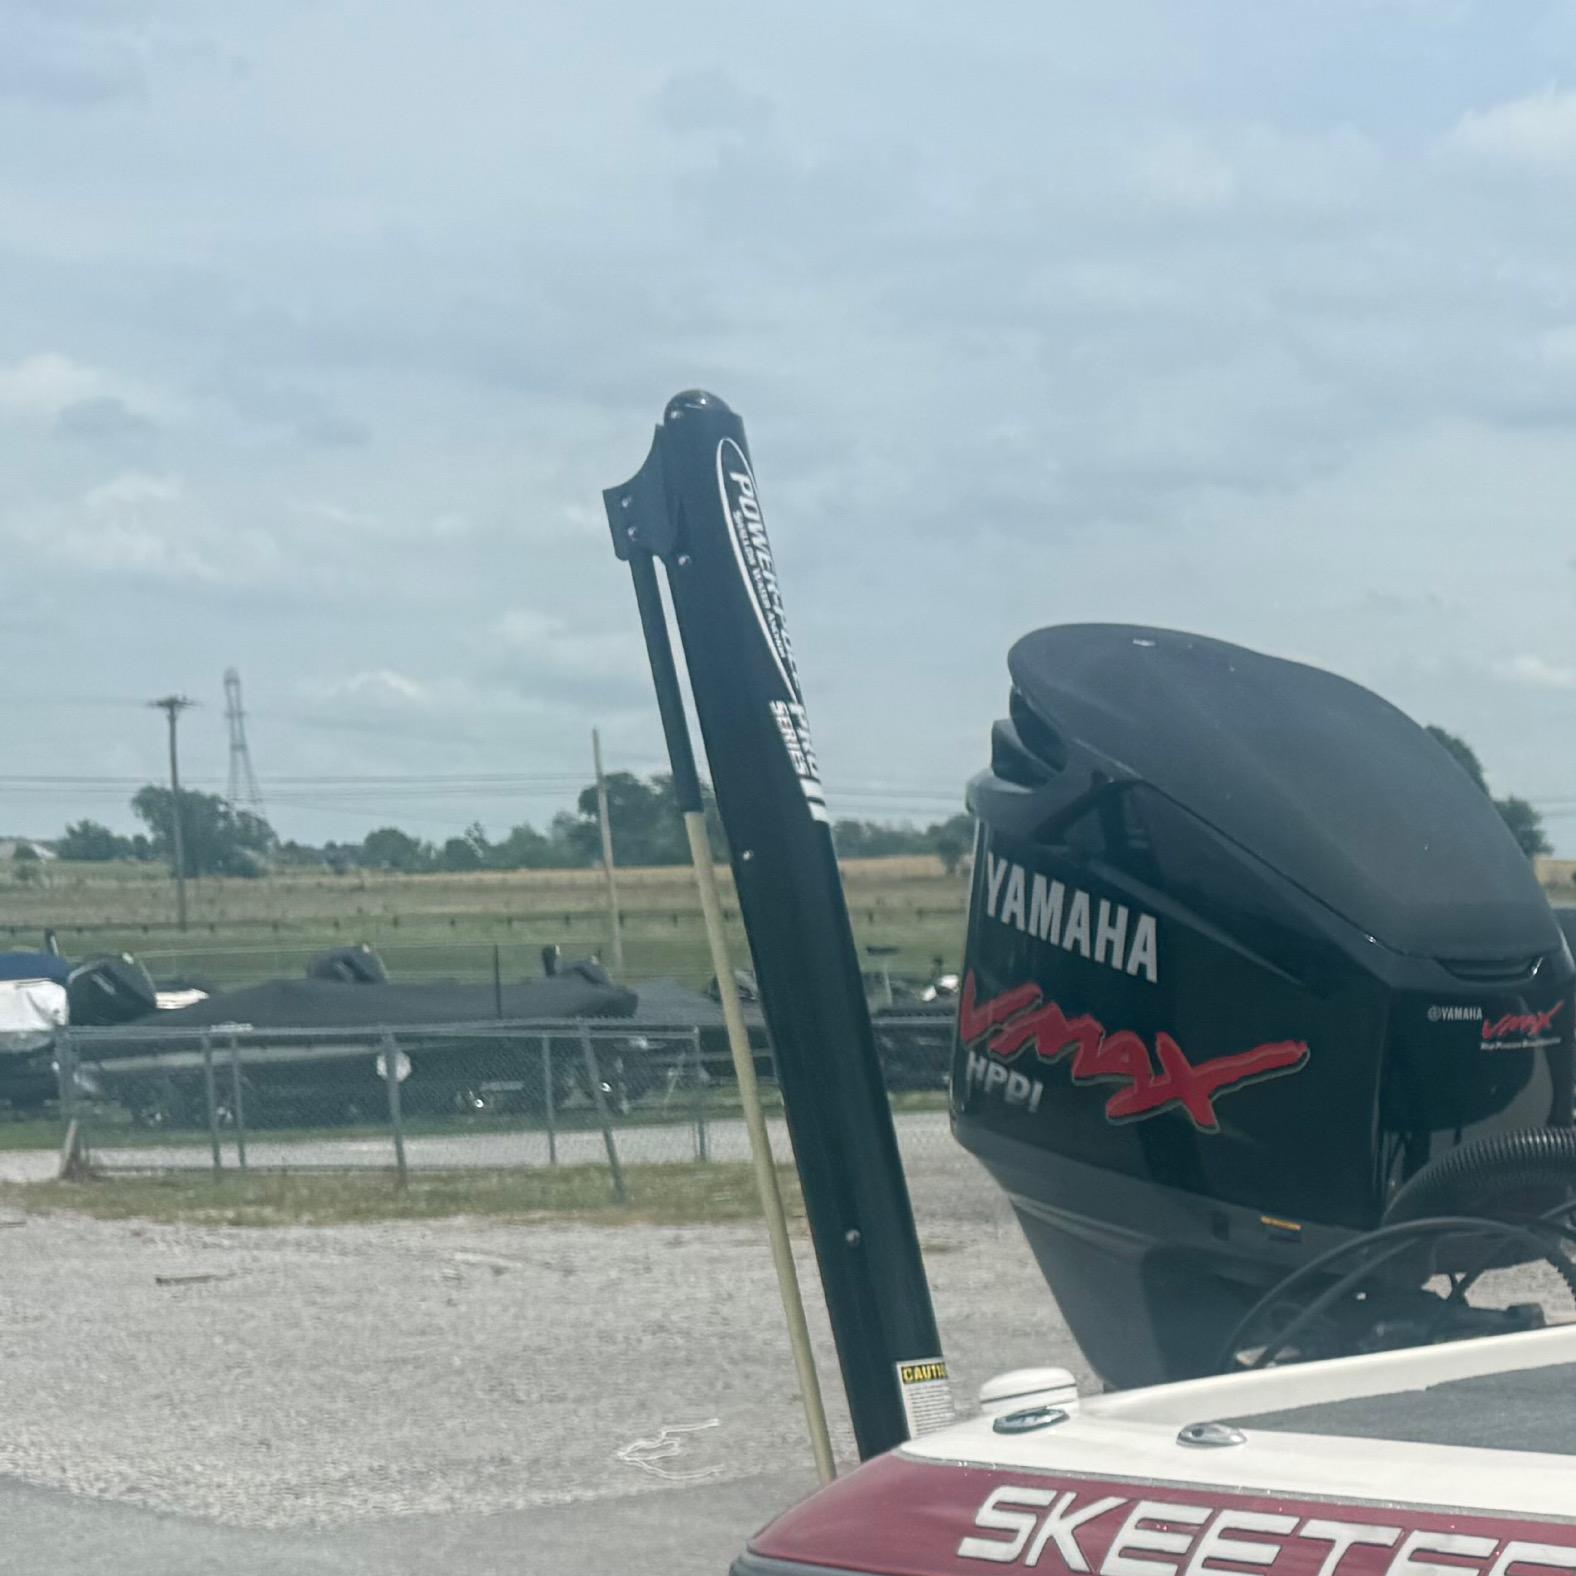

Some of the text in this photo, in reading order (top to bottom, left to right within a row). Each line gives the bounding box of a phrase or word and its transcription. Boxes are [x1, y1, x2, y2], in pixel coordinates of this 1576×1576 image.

[987, 851, 1158, 984] YAMAHA
[1441, 1006, 1483, 1021] YAMAHA
[966, 1051, 1044, 1112] HPDI
